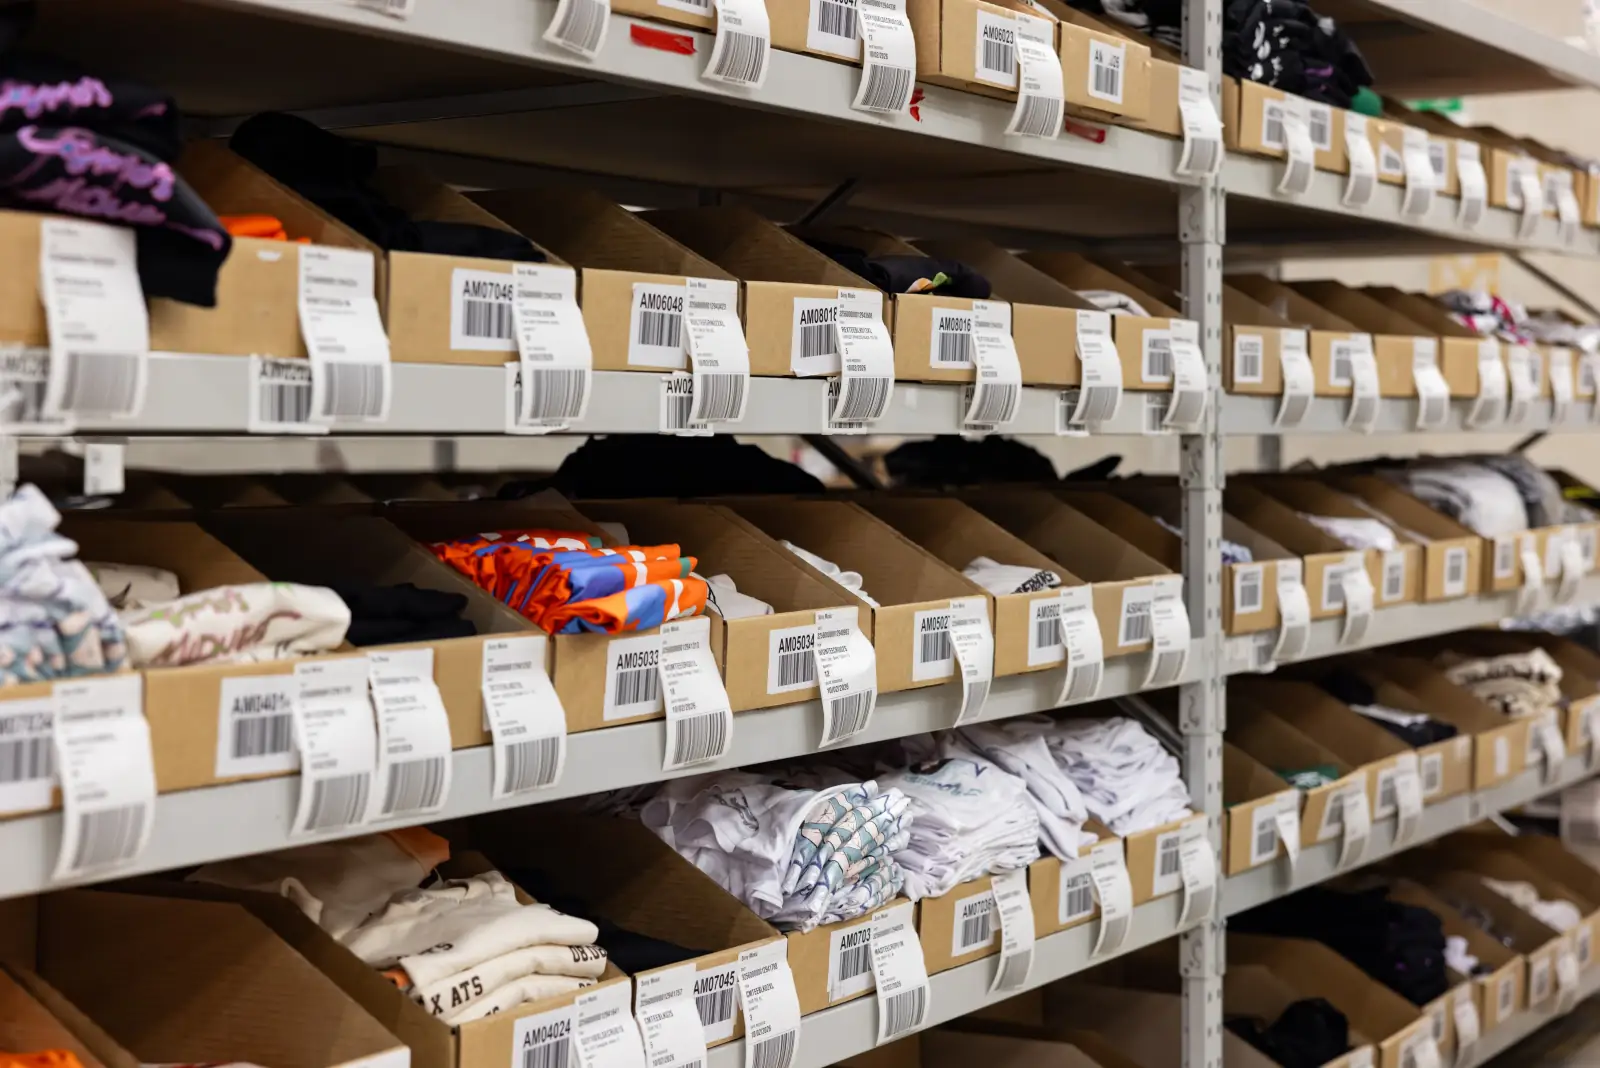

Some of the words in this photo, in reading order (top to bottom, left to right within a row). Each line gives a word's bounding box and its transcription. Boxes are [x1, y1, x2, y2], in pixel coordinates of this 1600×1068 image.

[983, 24, 1014, 45] AM06023
[640, 292, 683, 312] AM06048
[939, 317, 972, 332] AM08016
[666, 379, 693, 394] AW02
[920, 615, 951, 632] AM0502
[778, 633, 815, 654] AM05034
[616, 649, 659, 670] AM05033
[840, 928, 871, 950] AM0703
[693, 970, 735, 994] AM07045
[430, 993, 444, 1016] X
[451, 975, 483, 1008] ATS
[523, 1018, 571, 1048] AM04024
